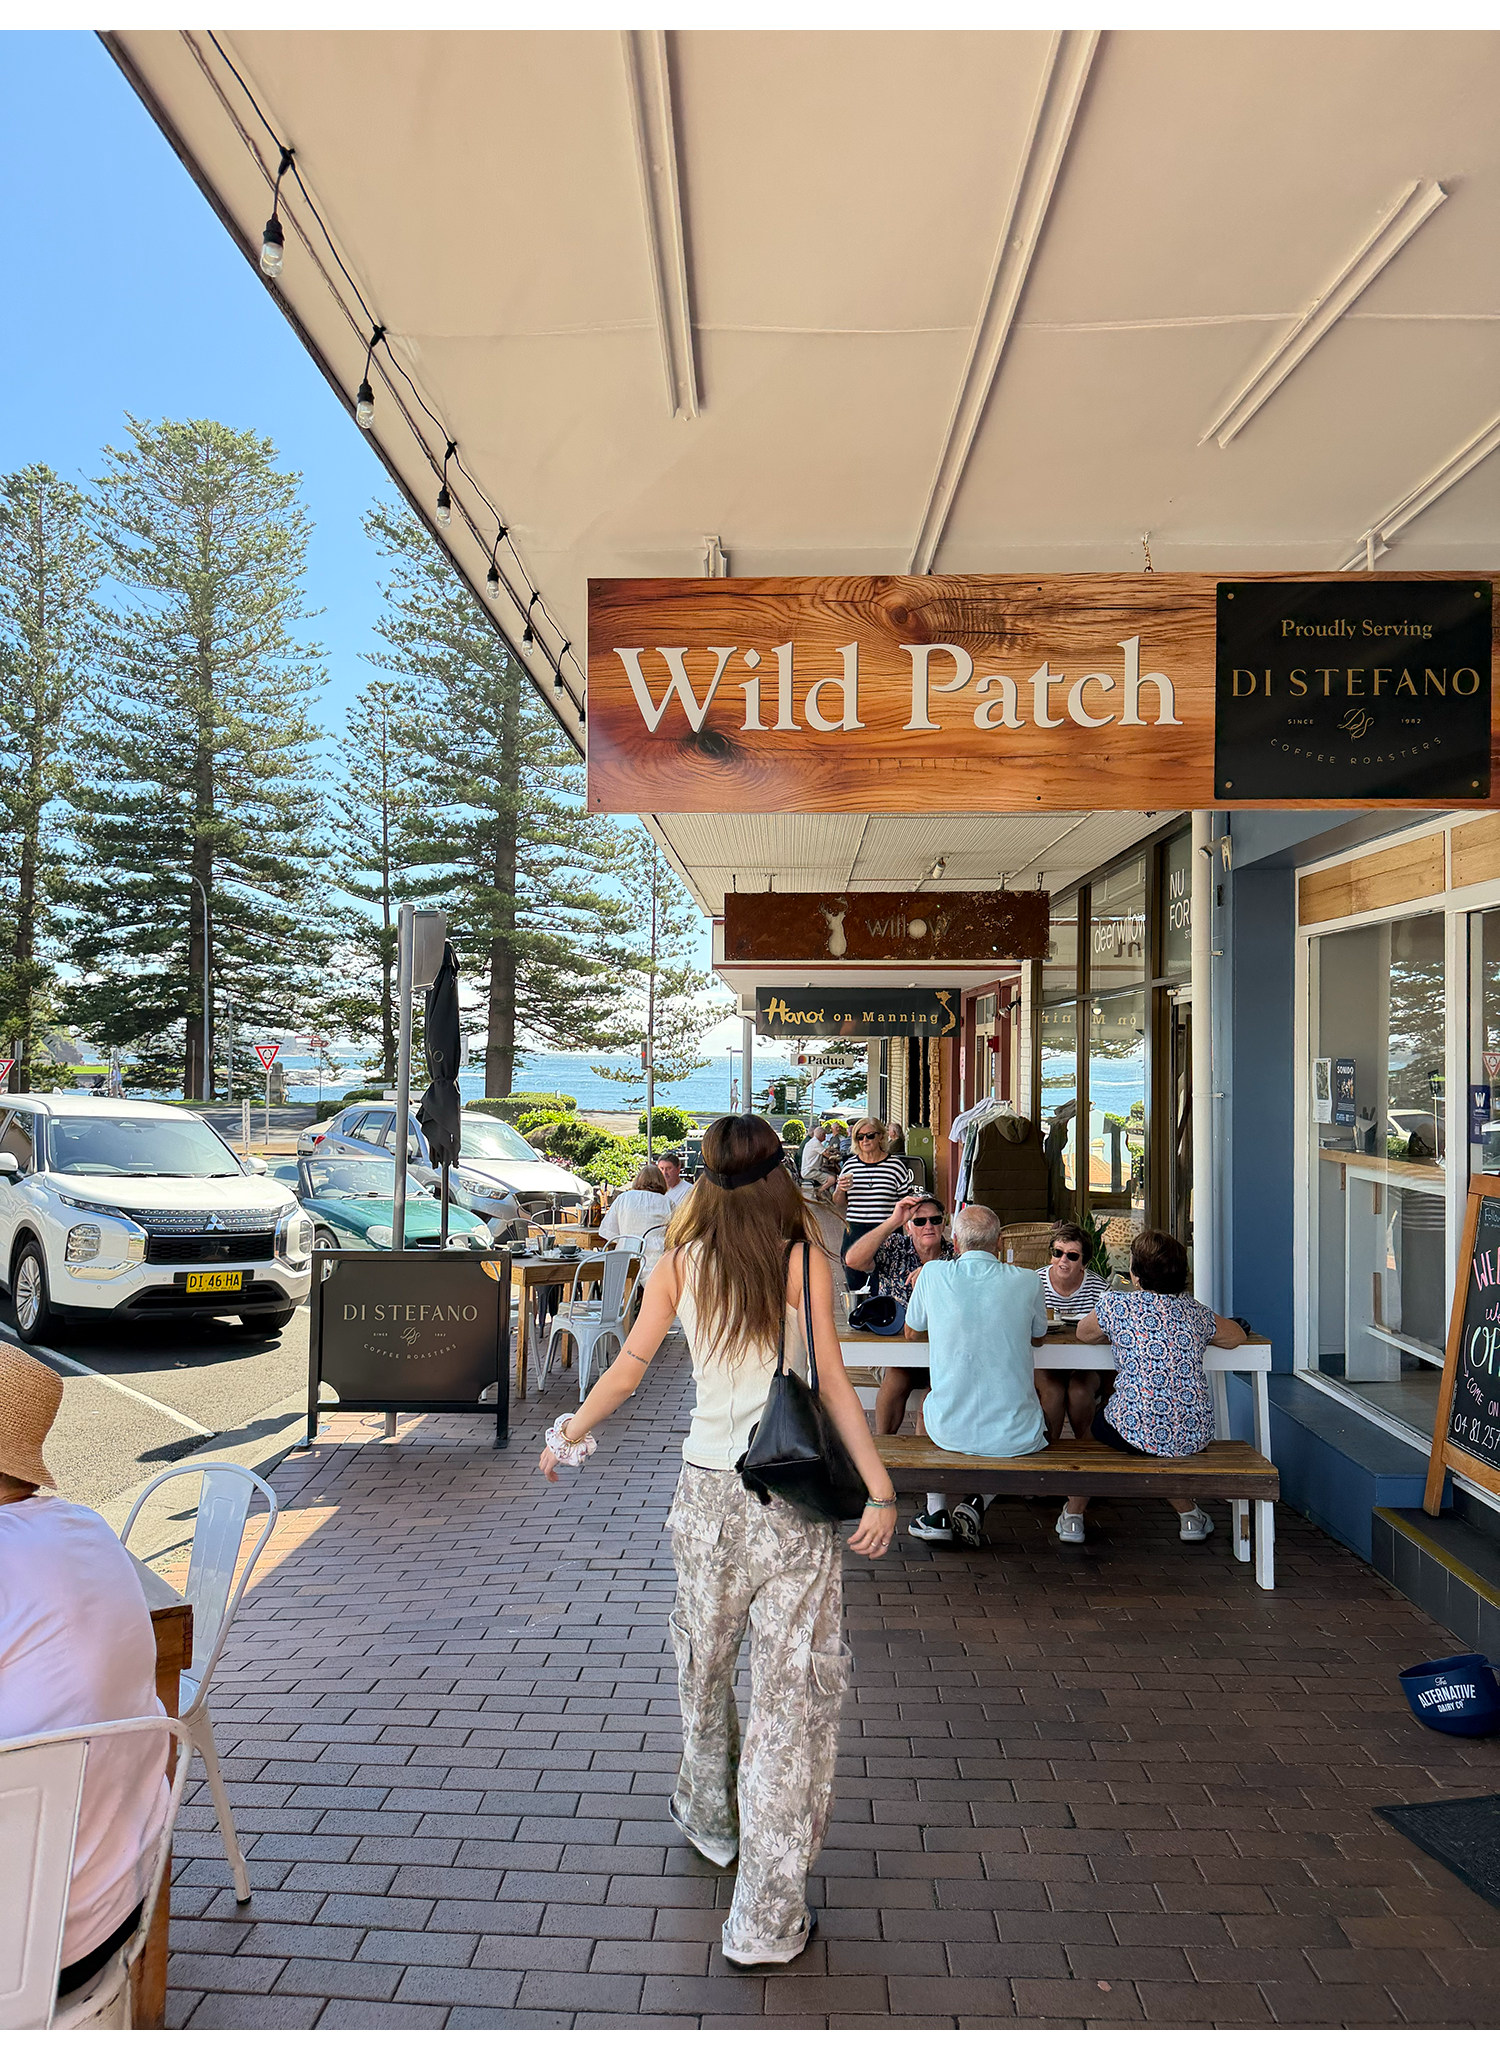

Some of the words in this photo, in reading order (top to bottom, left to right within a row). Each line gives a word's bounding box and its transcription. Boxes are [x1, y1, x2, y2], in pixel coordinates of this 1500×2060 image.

[1281, 619, 1356, 639] Proudly
[1362, 619, 1433, 639] Serving
[612, 641, 866, 734] Wild
[898, 635, 1184, 732] Patch
[1232, 669, 1272, 697] DI
[1289, 667, 1480, 697] STEFANO
[1287, 717, 1314, 725] SINCE
[1400, 717, 1423, 725] 1982
[1270, 738, 1337, 765] COFFEE
[1350, 736, 1443, 765] ROASTERS
[1169, 868, 1185, 900] NU
[864, 913, 952, 939] willow
[1169, 898, 1192, 931] FOR
[762, 997, 825, 1025] Hanoi
[833, 1011, 853, 1022] on
[862, 1011, 939, 1024] Manning
[807, 1055, 845, 1066] Padua
[343, 1304, 366, 1321] DI
[374, 1304, 478, 1321] STEFANO
[363, 1343, 400, 1359] COFFEE
[406, 1343, 457, 1360] ROASTERS
[1470, 1326, 1500, 1376] OP
[1466, 1377, 1484, 1406] COME
[1454, 1413, 1468, 1435] 04
[1417, 1684, 1476, 1709] ALTERNATIVE
[1437, 1702, 1455, 1713] DAIRY
